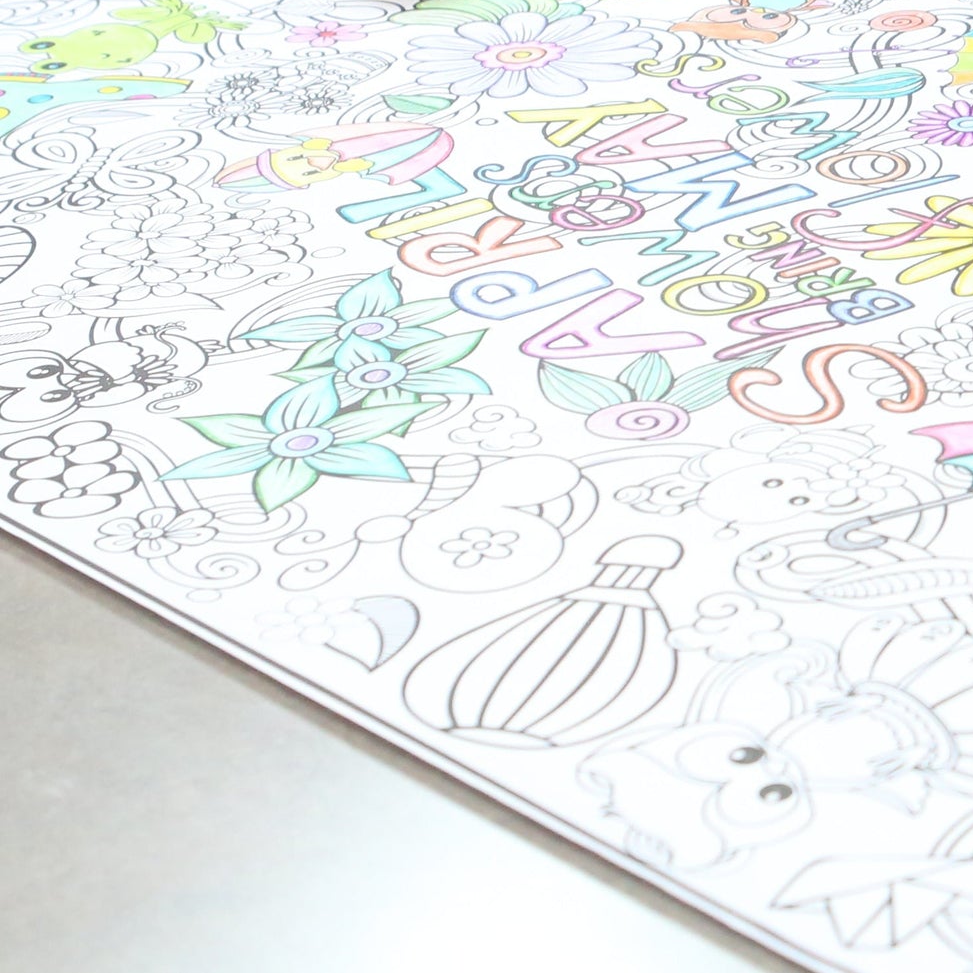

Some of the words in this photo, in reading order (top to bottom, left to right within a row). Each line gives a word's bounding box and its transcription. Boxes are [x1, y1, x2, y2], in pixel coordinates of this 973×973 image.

[506, 98, 816, 232] MAY
[336, 164, 707, 359] APRIL
[724, 220, 914, 326] BRING
